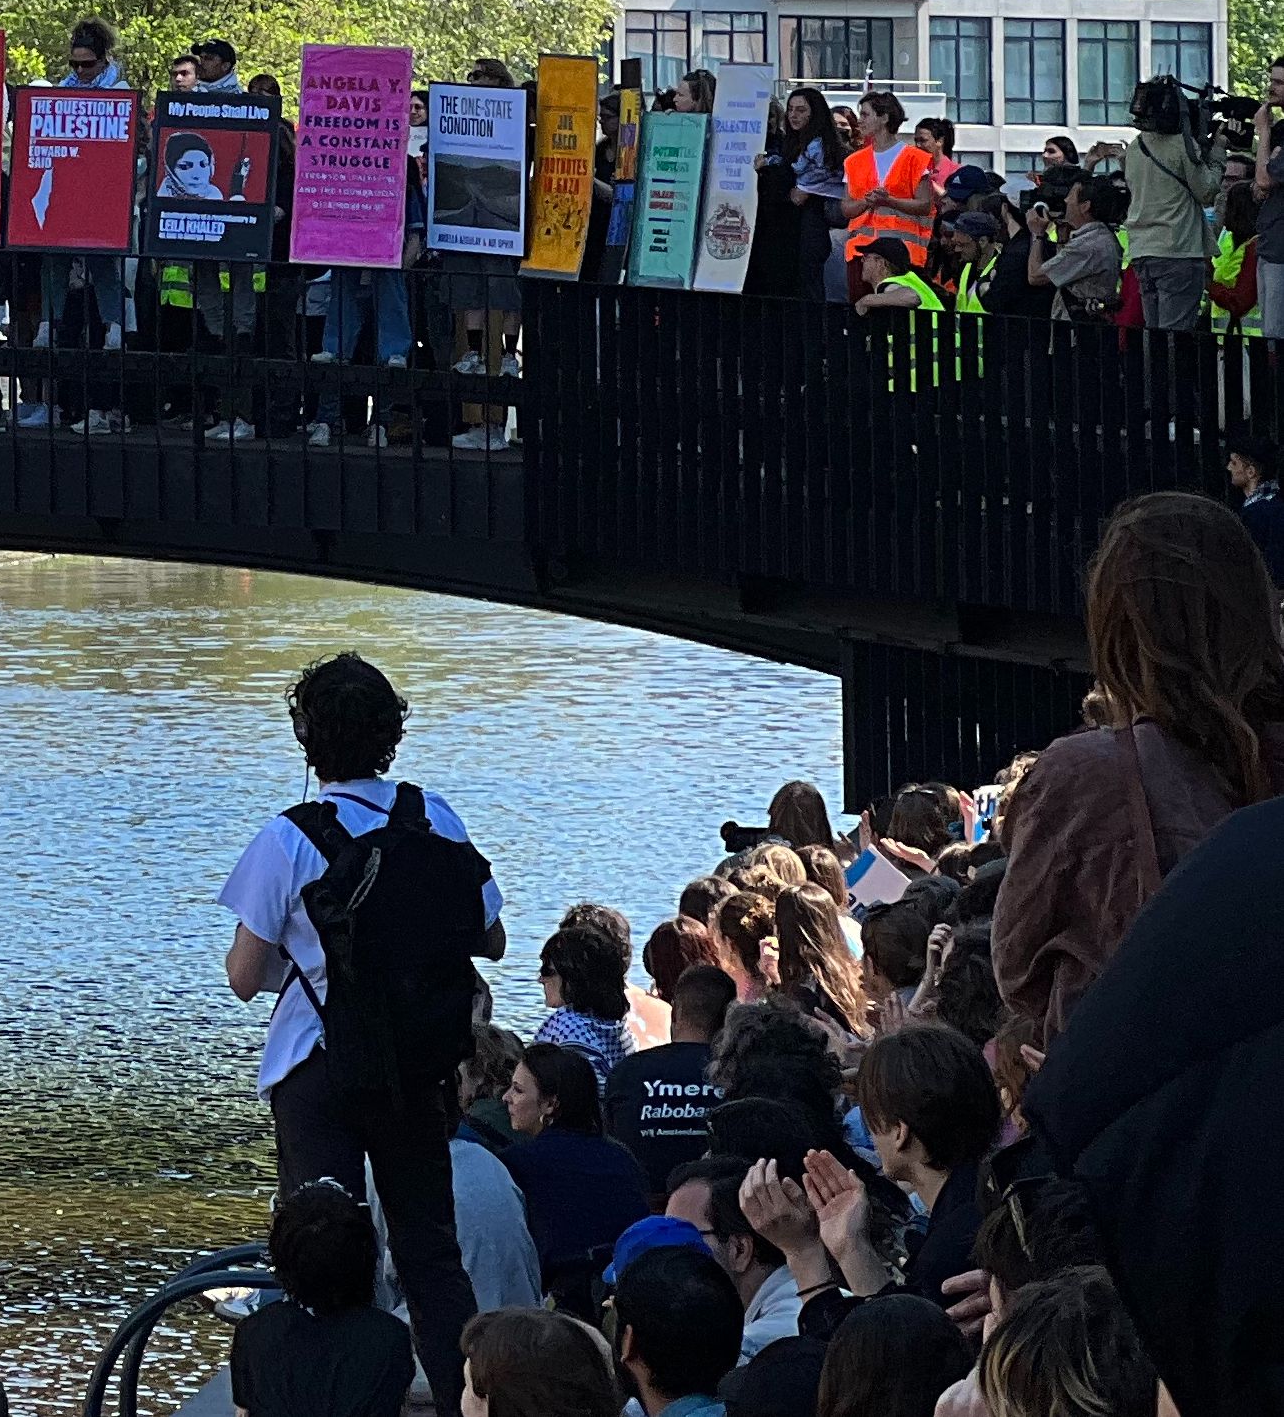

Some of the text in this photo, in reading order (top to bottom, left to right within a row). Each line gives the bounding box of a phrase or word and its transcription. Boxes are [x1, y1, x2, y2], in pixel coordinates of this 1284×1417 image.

[306, 75, 404, 94] ANGELA Y.
[31, 100, 132, 116] THE QUESTION OF
[169, 101, 270, 120] My People Shall Live
[326, 95, 382, 113] DAVIS
[439, 95, 514, 119] THE ONE-STATE
[30, 115, 130, 139] PALESTINE
[304, 115, 400, 131] FREEDOM IS
[439, 116, 494, 138] CONDITION
[714, 118, 762, 134] PALESTINE
[301, 135, 312, 147] A
[318, 135, 400, 150] CONSTANT
[28, 146, 80, 158] EDWARD W.
[28, 157, 52, 169] SAID
[310, 154, 391, 169] STRUGGLE
[539, 156, 588, 176] FOOTNOTES
[556, 177, 580, 195] GAZA
[159, 218, 225, 235] LEILA KHALED
